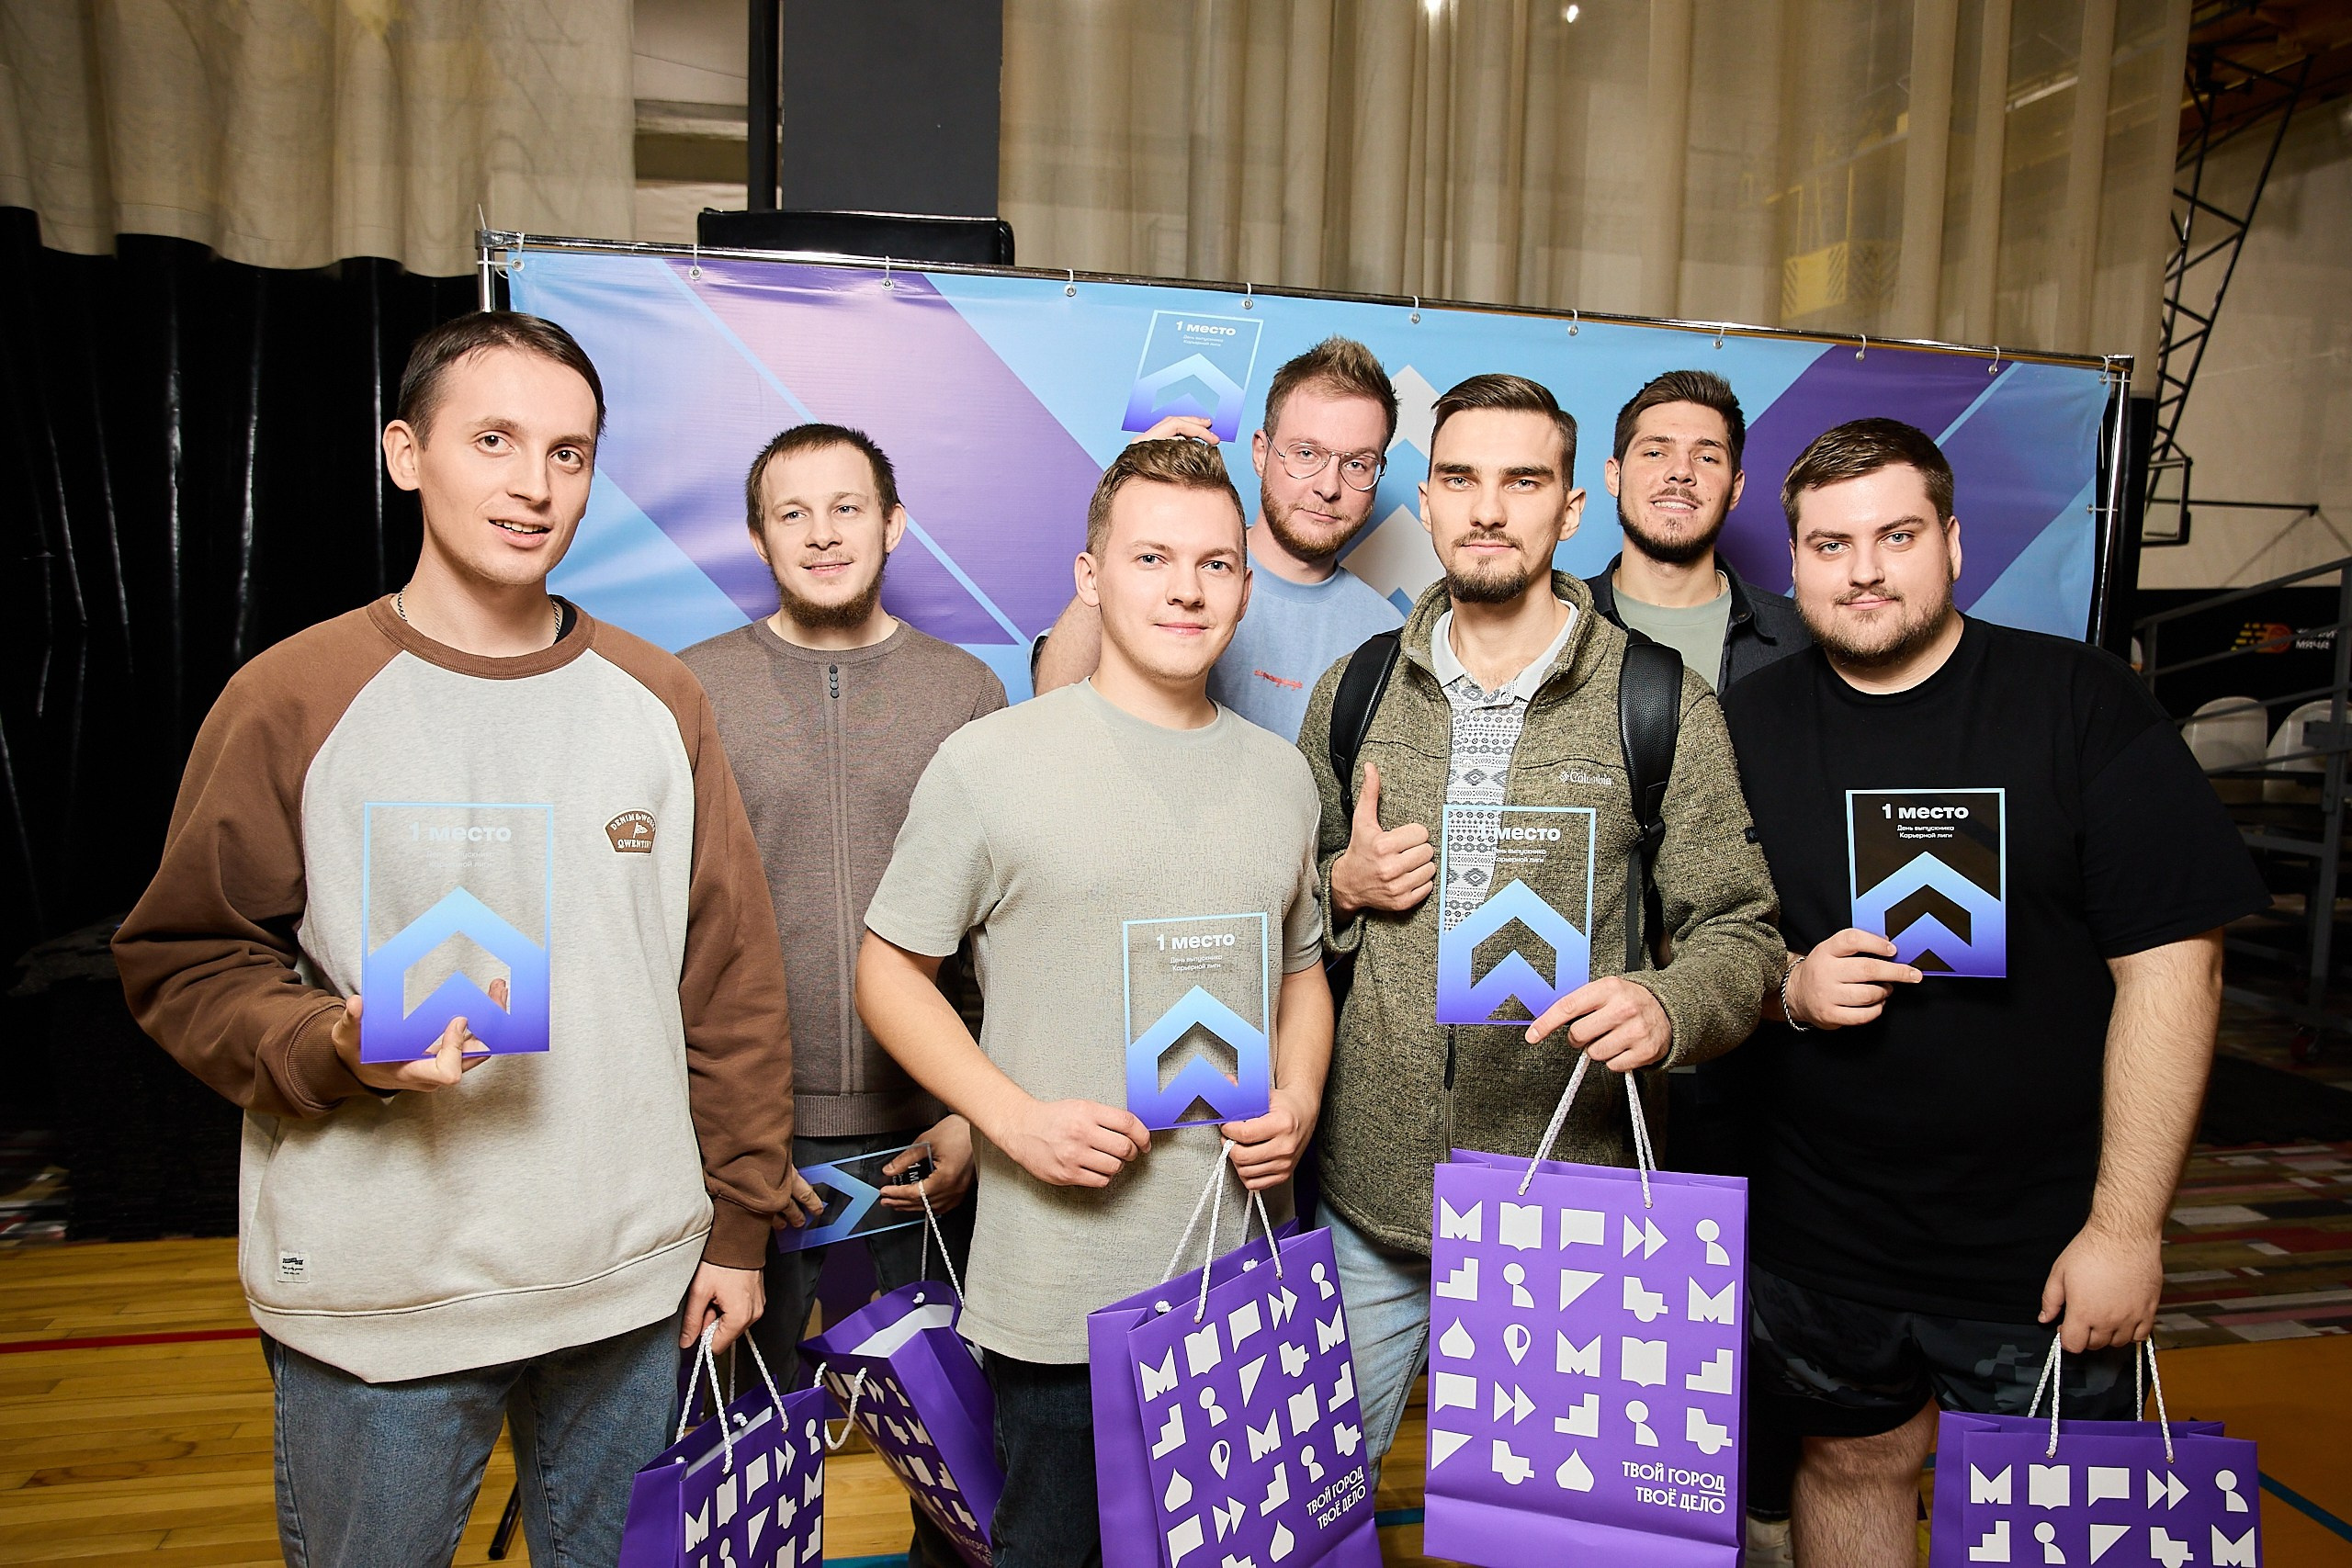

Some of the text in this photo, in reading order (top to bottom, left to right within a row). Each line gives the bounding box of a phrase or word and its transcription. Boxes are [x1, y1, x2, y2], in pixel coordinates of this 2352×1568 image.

[1176, 321, 1237, 336] 1 место
[1882, 803, 1969, 819] 1 место
[428, 826, 513, 842] место
[1493, 827, 1561, 841] место
[1899, 831, 1936, 840] Карьерной
[1156, 933, 1236, 951] 1 место
[1622, 1461, 1726, 1494] ТВОЙ ГОРОД
[1306, 1465, 1365, 1517] ТВОЙ ГОРОД
[1317, 1484, 1366, 1529] ТВОЁ ДЕЛО
[1634, 1486, 1725, 1514] ТВОЁ ДЕЛО
